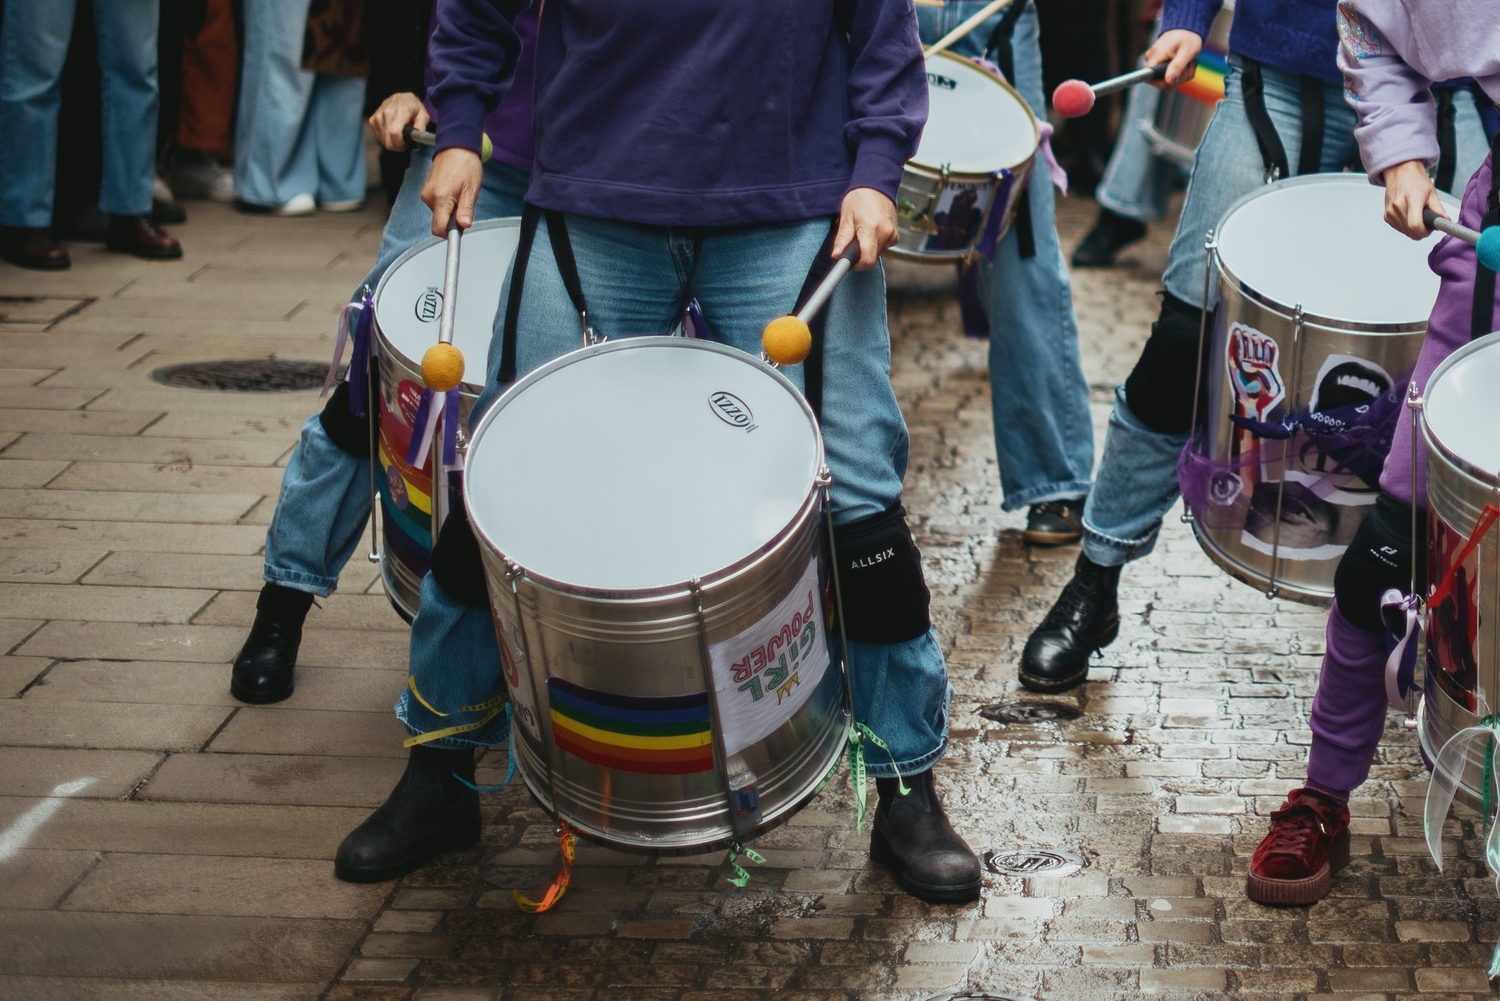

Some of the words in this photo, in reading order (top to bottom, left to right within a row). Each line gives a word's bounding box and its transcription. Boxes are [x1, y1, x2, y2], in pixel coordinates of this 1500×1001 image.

[422, 293, 437, 320] IZZO
[712, 395, 748, 423] IZZO
[851, 547, 895, 569] ALLSIX
[730, 590, 814, 684] POWER
